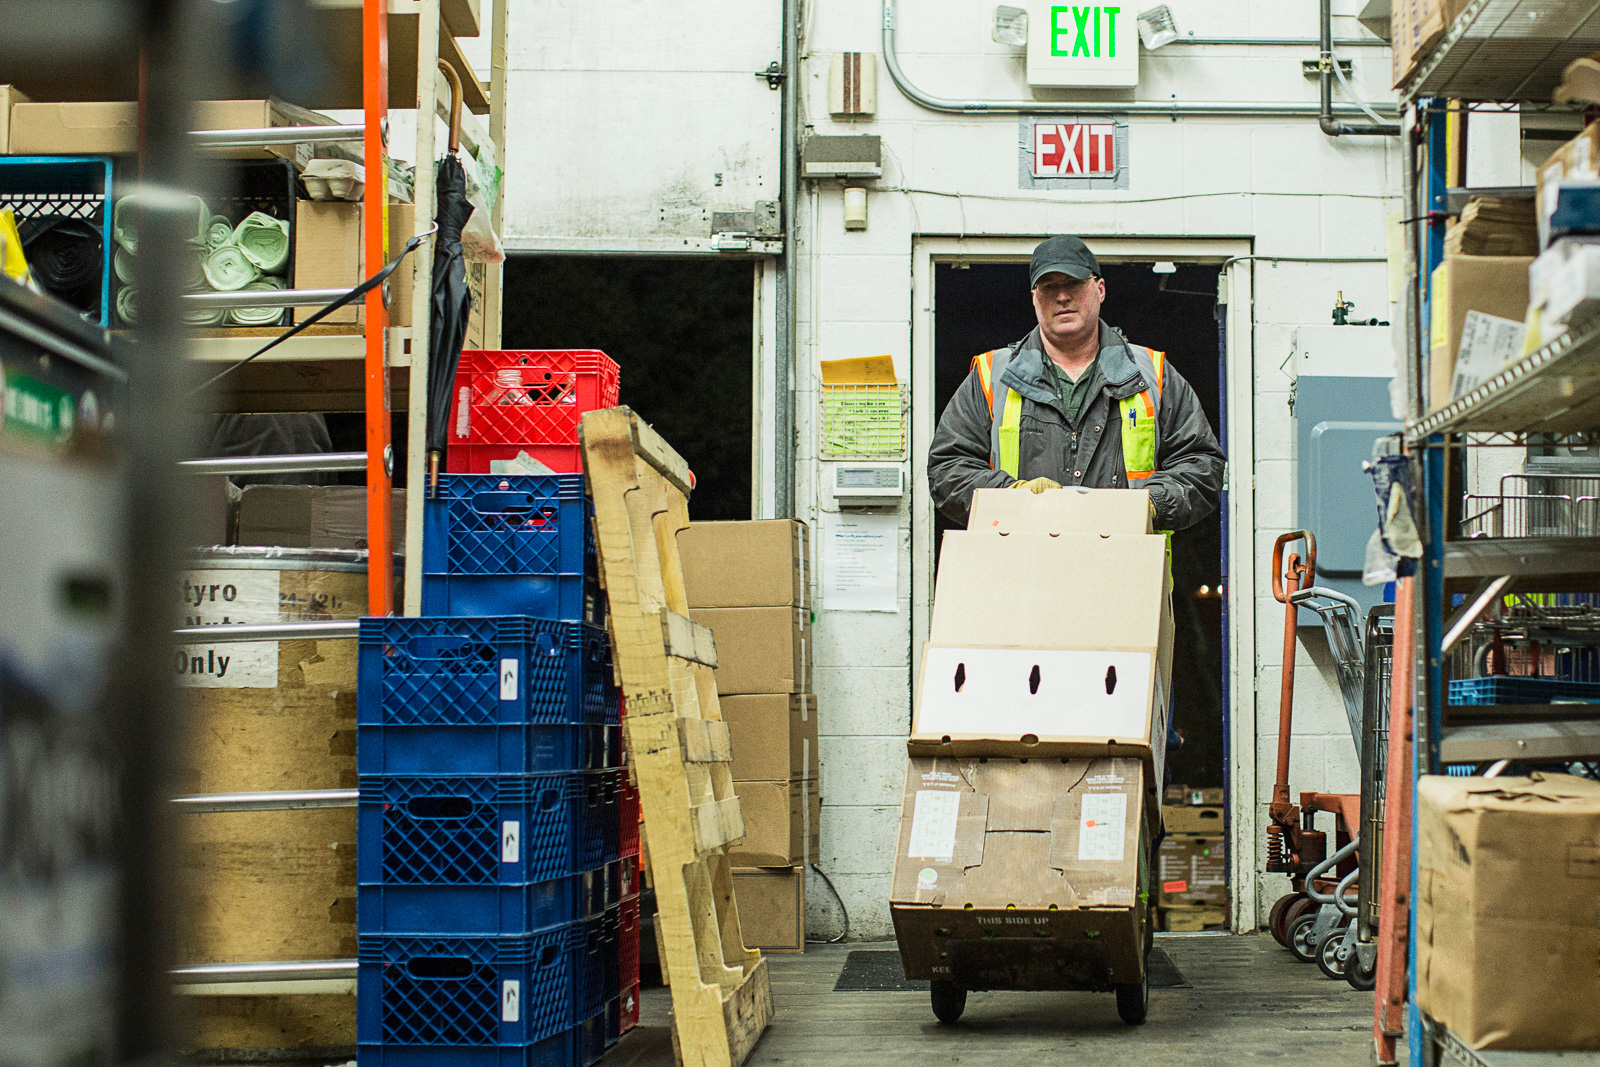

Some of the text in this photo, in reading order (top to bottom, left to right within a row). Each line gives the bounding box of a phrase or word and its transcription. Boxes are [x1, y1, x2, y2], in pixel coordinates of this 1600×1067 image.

[1050, 6, 1121, 58] EXIT
[1035, 124, 1113, 174] EXIT
[183, 579, 238, 607] tyro
[174, 649, 231, 678] Only
[976, 916, 1049, 925] THIS SIDE UP
